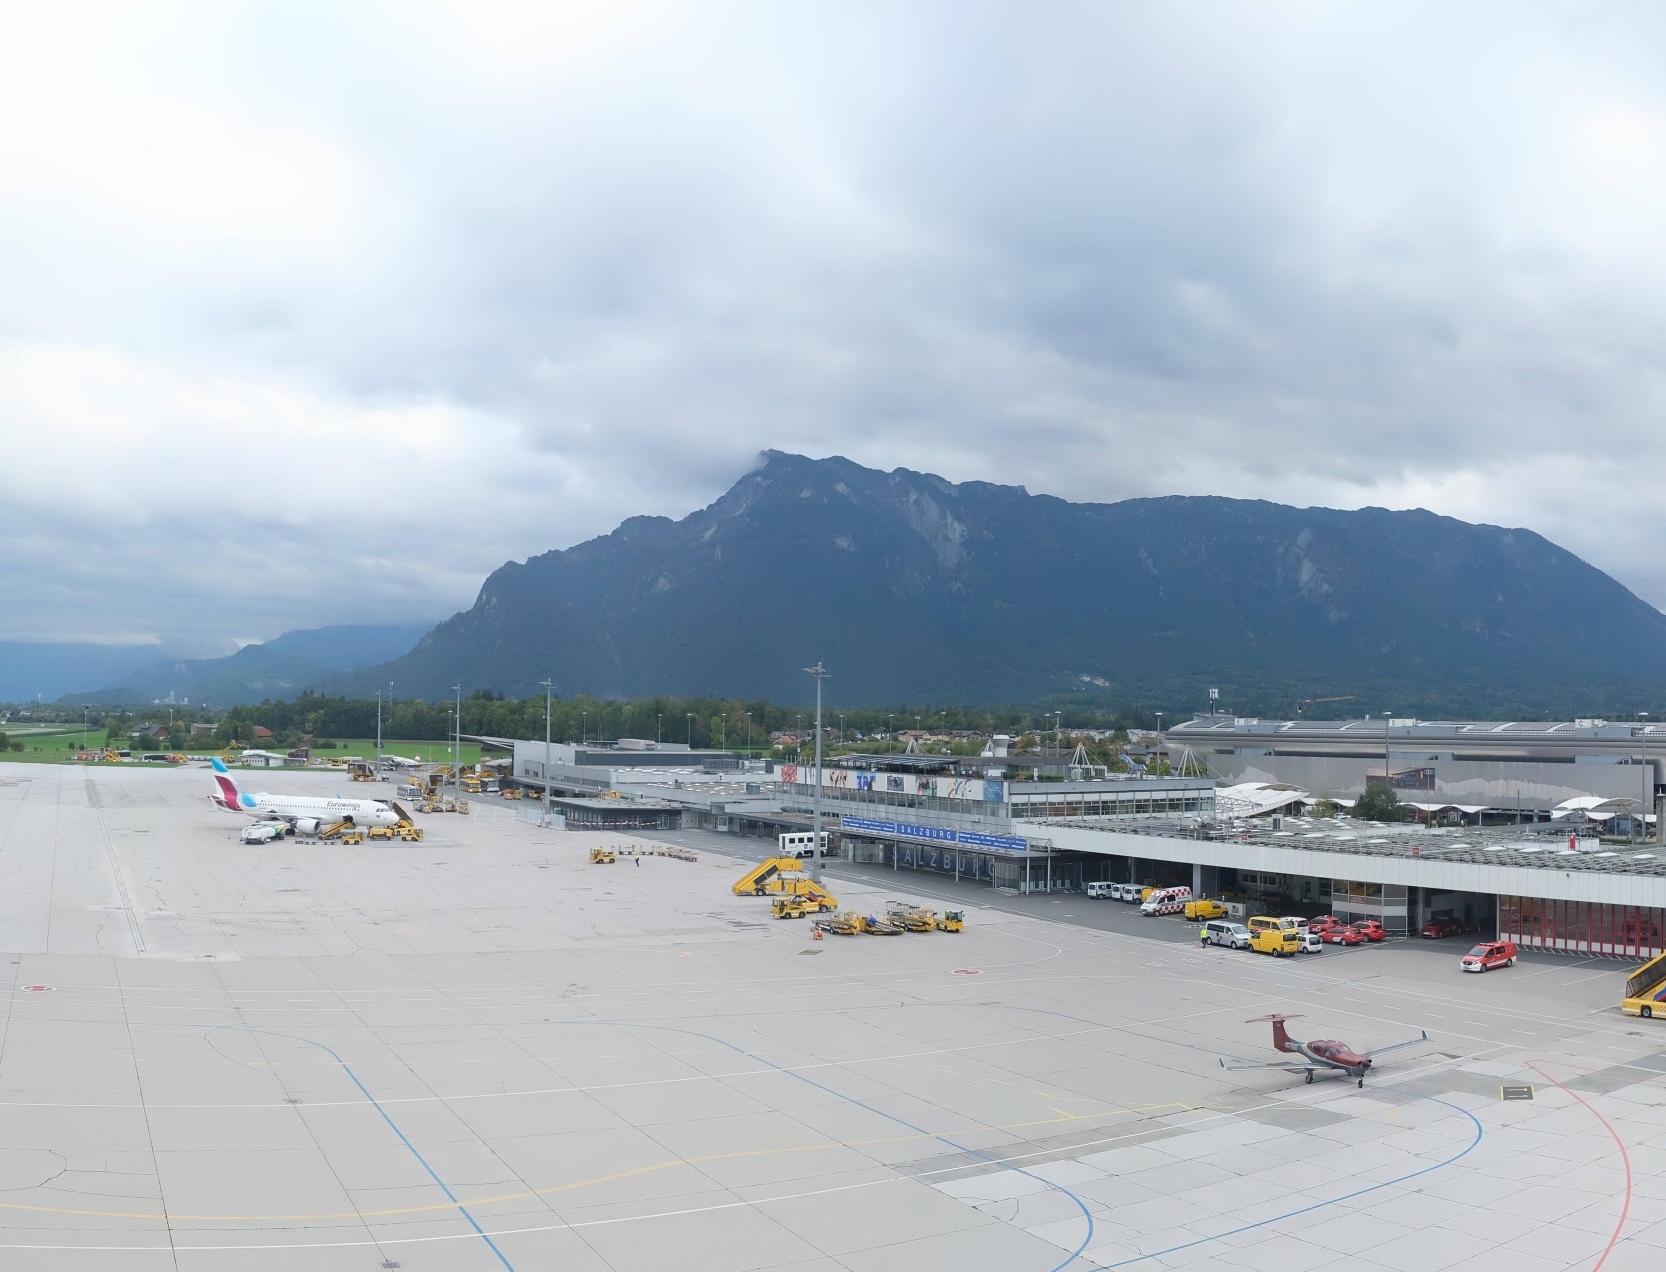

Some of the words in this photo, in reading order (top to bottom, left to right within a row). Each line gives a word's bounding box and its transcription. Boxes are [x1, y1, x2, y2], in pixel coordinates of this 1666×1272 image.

[326, 801, 361, 809] Eurowings
[900, 825, 952, 840] SALZBURG
[892, 847, 995, 877] SALZBURG
